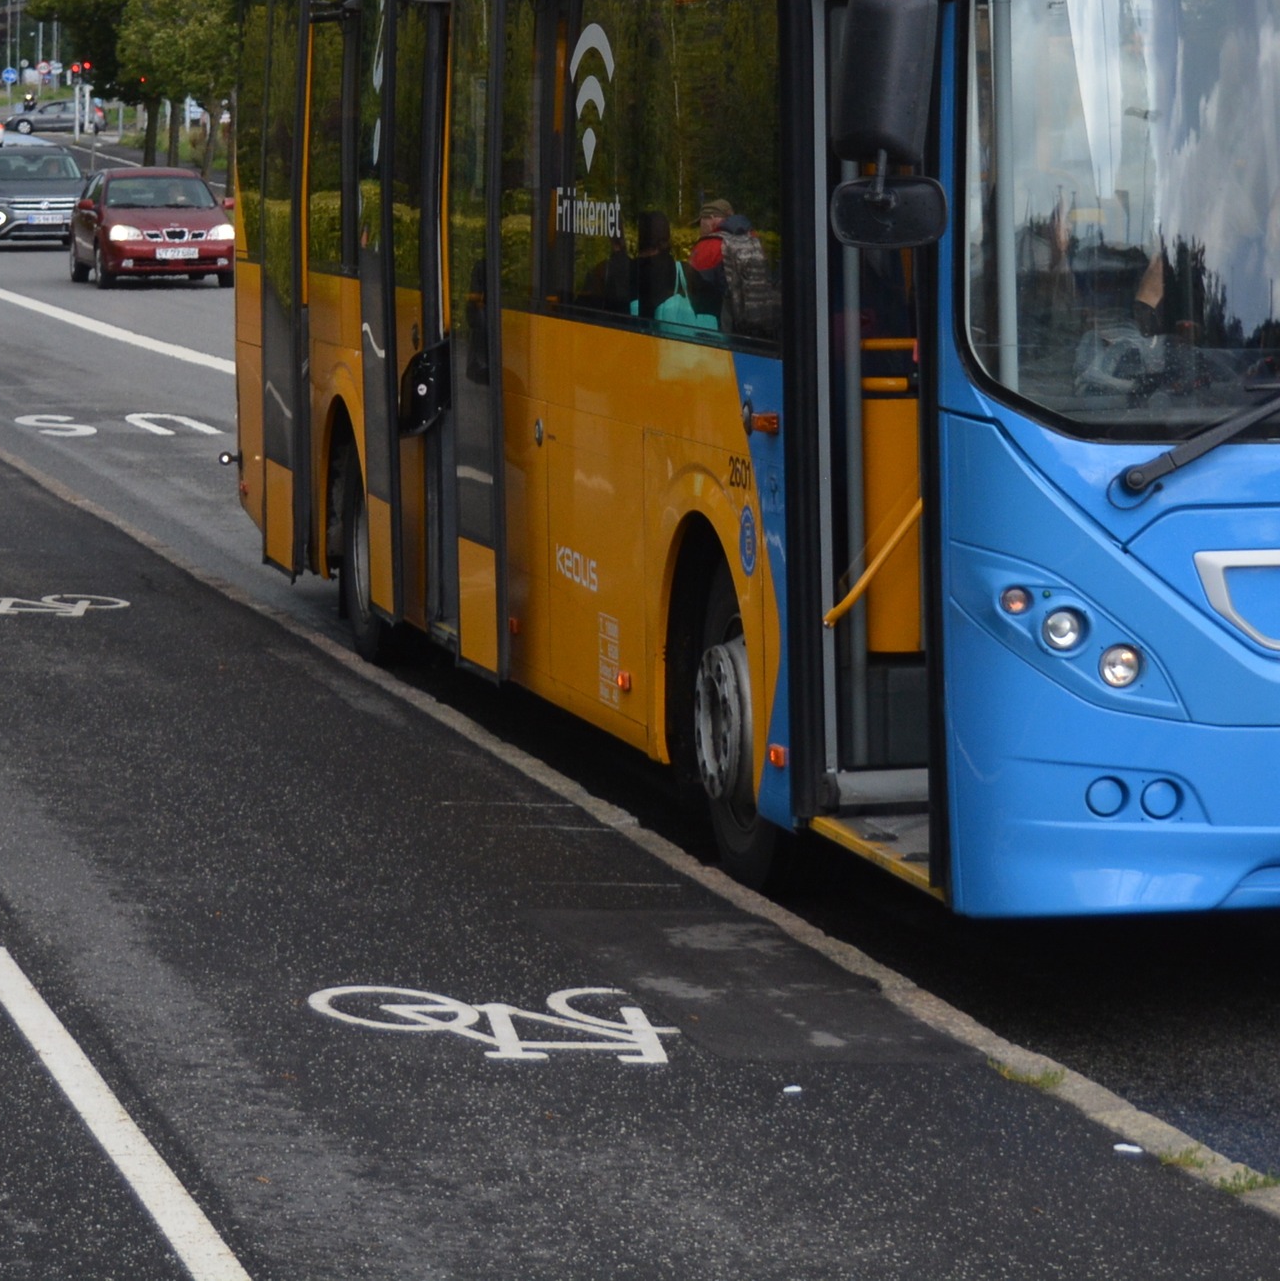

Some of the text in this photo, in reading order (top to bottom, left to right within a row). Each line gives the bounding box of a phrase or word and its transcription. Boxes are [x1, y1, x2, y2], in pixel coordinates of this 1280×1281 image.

[556, 186, 621, 238] Fri internet
[729, 456, 752, 491] 2601
